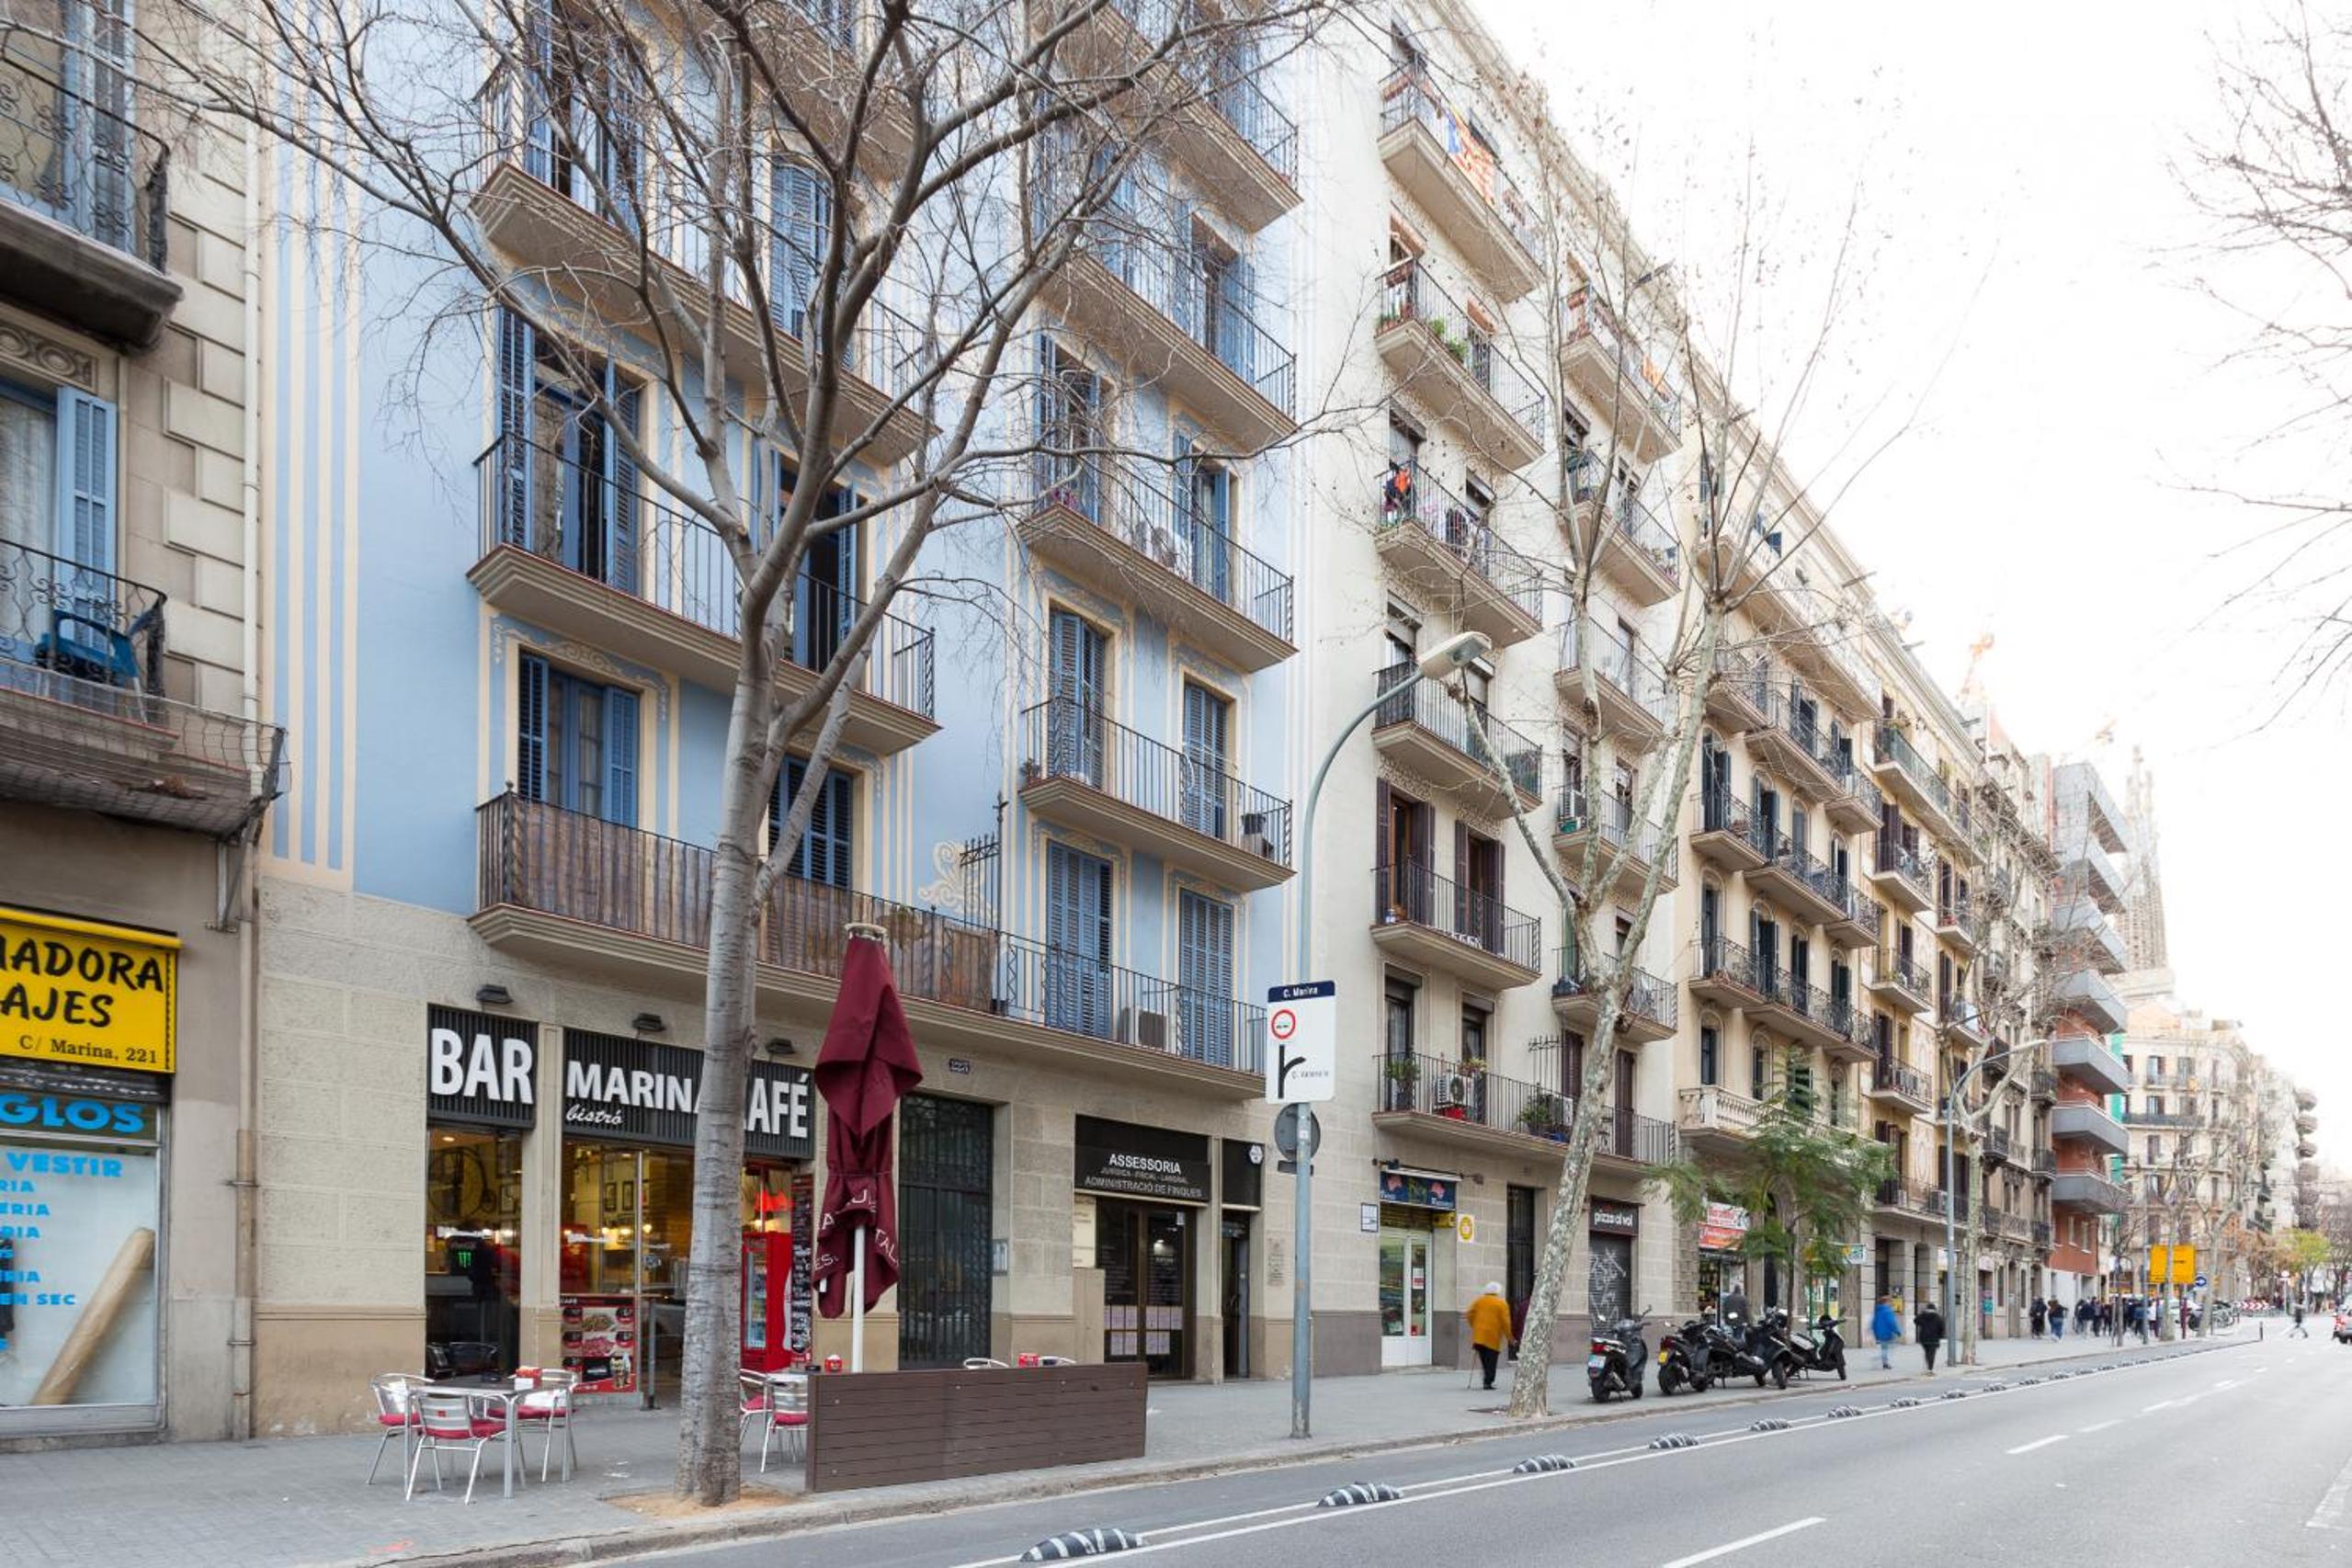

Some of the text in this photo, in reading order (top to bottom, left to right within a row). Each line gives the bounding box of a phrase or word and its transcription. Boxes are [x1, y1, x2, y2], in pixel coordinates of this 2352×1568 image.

[1292, 986, 1319, 997] Marina
[19, 1035, 157, 1064] C/ Marina, 221
[430, 1027, 534, 1105] BAR
[0, 1092, 145, 1133] GLOS
[566, 1060, 809, 1139] MARIN AFÉ
[6, 1152, 123, 1177] VESTIR
[1108, 1153, 1182, 1175] ASSESSORIA
[36, 1293, 75, 1305] SEC
